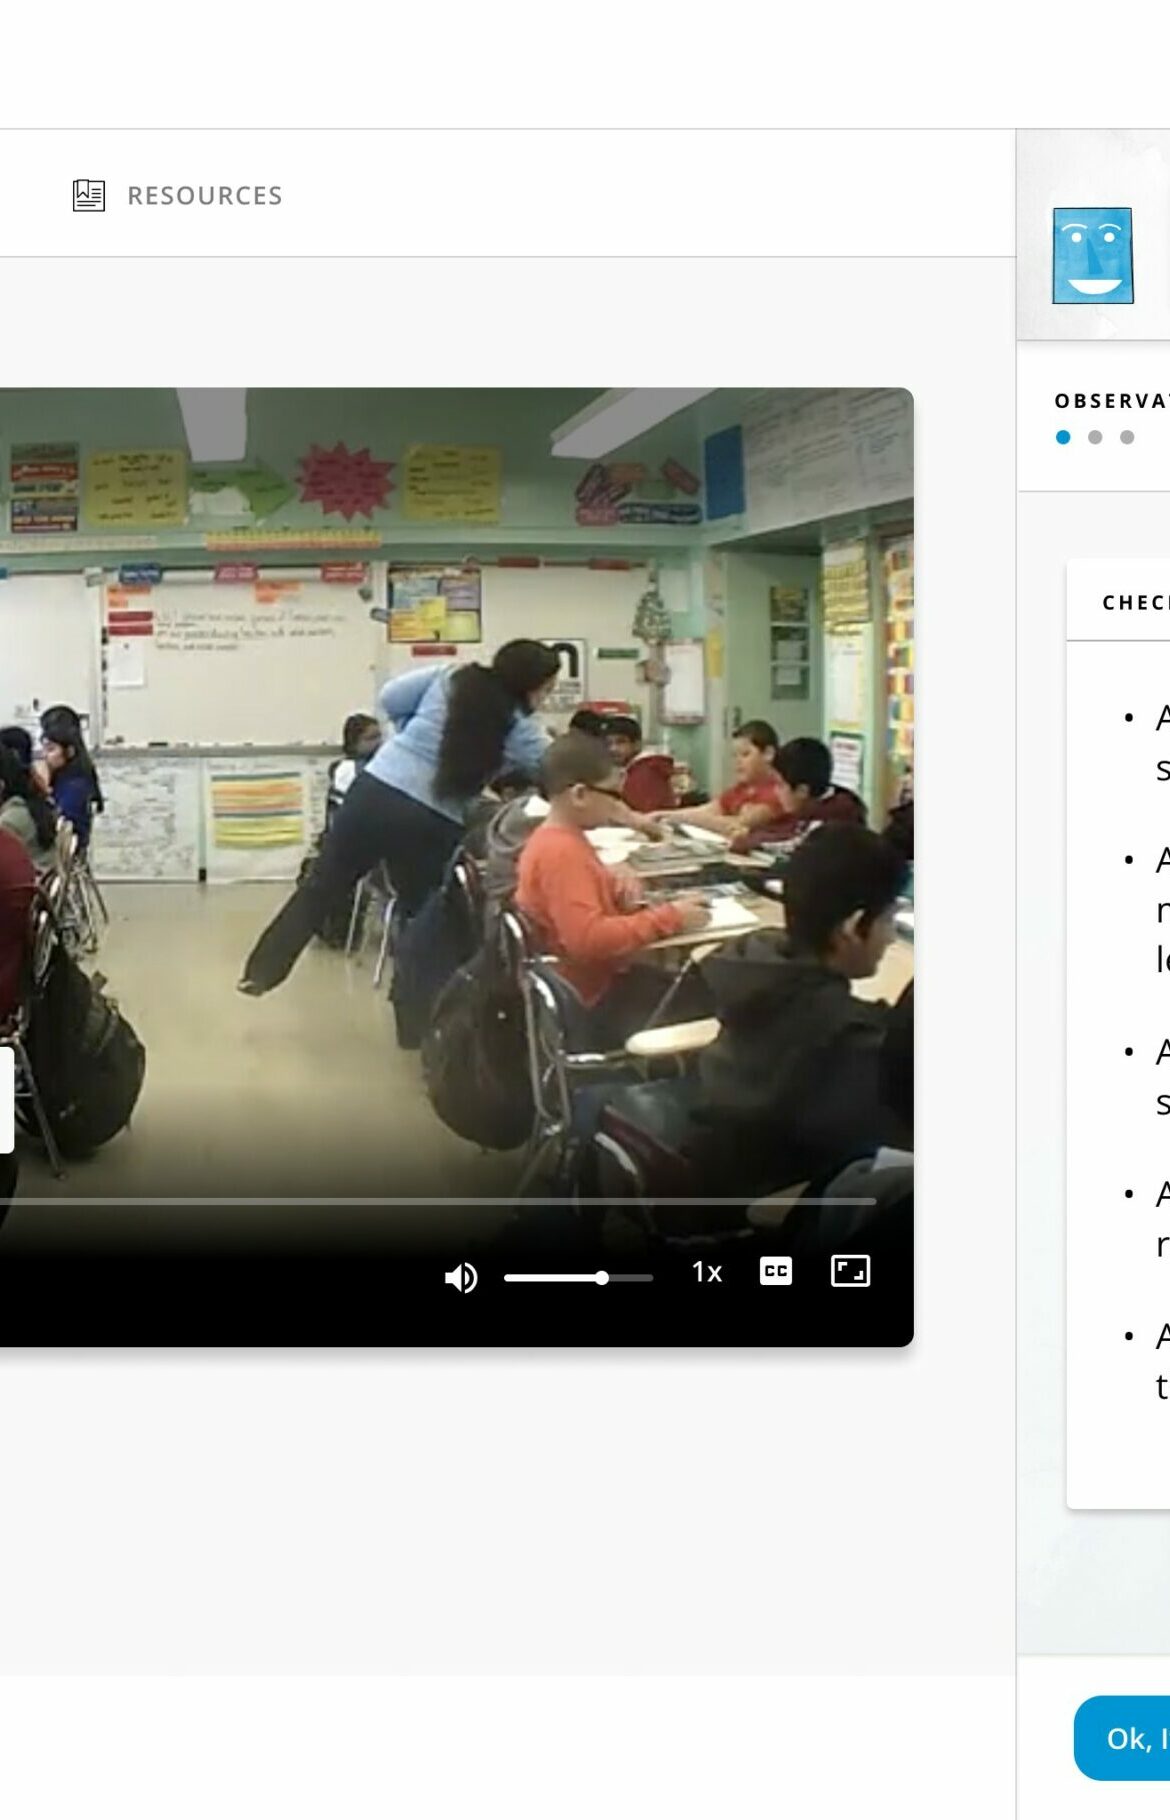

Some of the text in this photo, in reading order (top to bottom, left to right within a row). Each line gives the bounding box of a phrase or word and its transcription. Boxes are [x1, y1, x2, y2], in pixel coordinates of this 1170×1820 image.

[128, 186, 282, 205] RESOURCES
[1054, 392, 1170, 409] OBSERVA
[1102, 594, 1170, 611] CHEC
[692, 1260, 723, 1283] 1x
[1107, 1726, 1170, 1754] Ok, I
